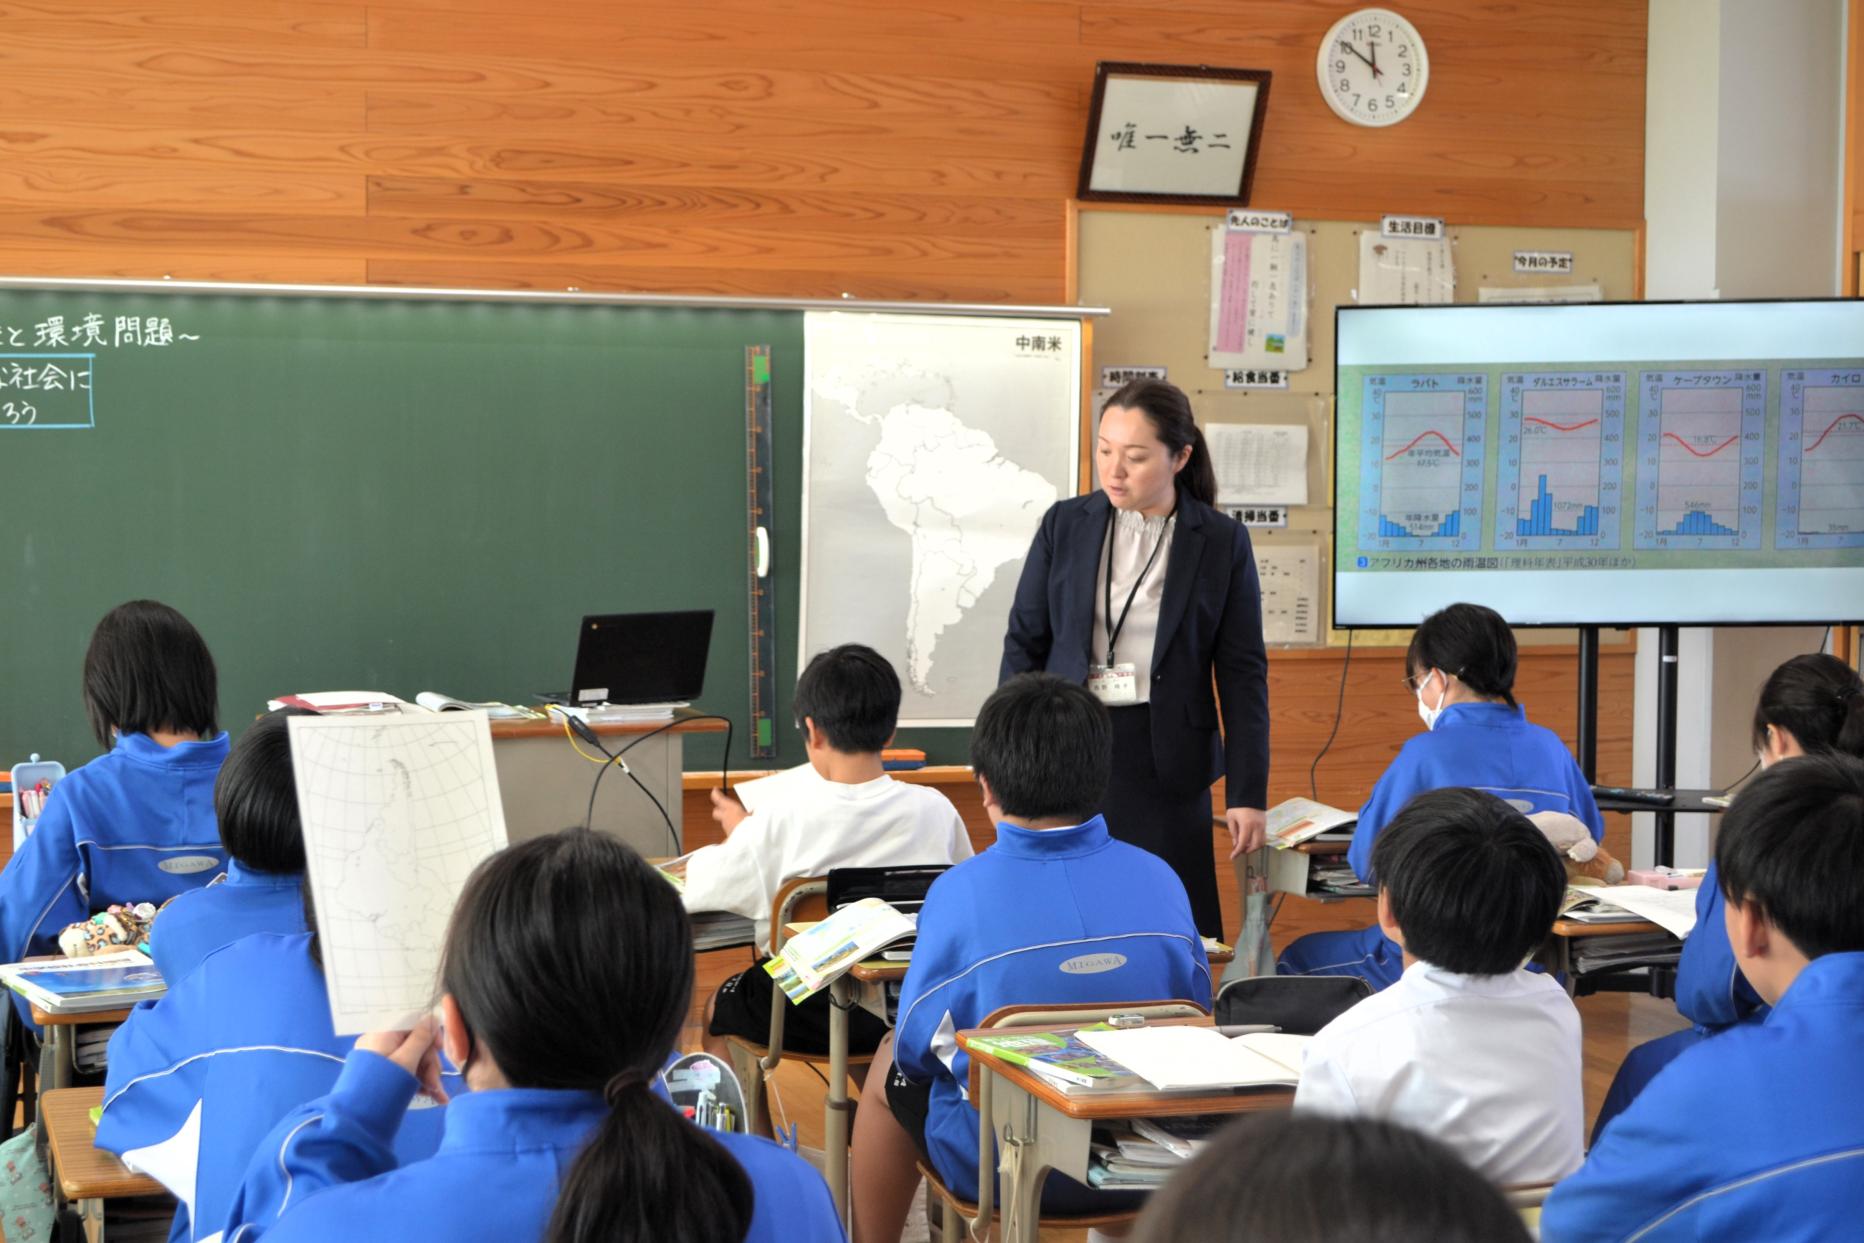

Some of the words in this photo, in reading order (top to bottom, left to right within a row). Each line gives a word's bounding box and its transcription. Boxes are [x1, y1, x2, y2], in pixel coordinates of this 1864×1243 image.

[1352, 29, 1363, 41] 11
[1368, 25, 1381, 38] 12
[1398, 44, 1407, 58] 2
[1335, 60, 1346, 73] 9
[1402, 63, 1411, 76] 3
[1340, 79, 1350, 92] 8
[1397, 82, 1406, 93] 4
[1352, 93, 1361, 107] 7
[1367, 98, 1378, 112] 6
[1385, 95, 1395, 108] 5
[1110, 122, 1232, 154] 唯一無二
[1230, 215, 1289, 229] 先人のことば
[1388, 220, 1436, 235] 生活目標
[1517, 255, 1569, 269] 今月の予定
[1015, 334, 1062, 352] 中南米
[1232, 370, 1280, 384] 給食当番
[1534, 377, 1593, 387] ダルエスサラーム
[1673, 375, 1733, 385] ケープタウン
[1831, 374, 1861, 384] カイロ
[1411, 378, 1439, 388] ラバト
[1746, 384, 1761, 392] 600
[1605, 410, 1619, 418] 500
[1745, 408, 1760, 416] 500
[1509, 435, 1518, 443] 20
[1744, 432, 1760, 440] 400
[1648, 457, 1656, 465] 10
[1744, 457, 1759, 465] 300
[1789, 457, 1798, 465] 10
[1743, 482, 1758, 490] 200
[1464, 508, 1477, 516] 100
[1743, 506, 1757, 514] 100
[1591, 539, 1599, 547] 12
[1067, 956, 1122, 970] MIGAWA
